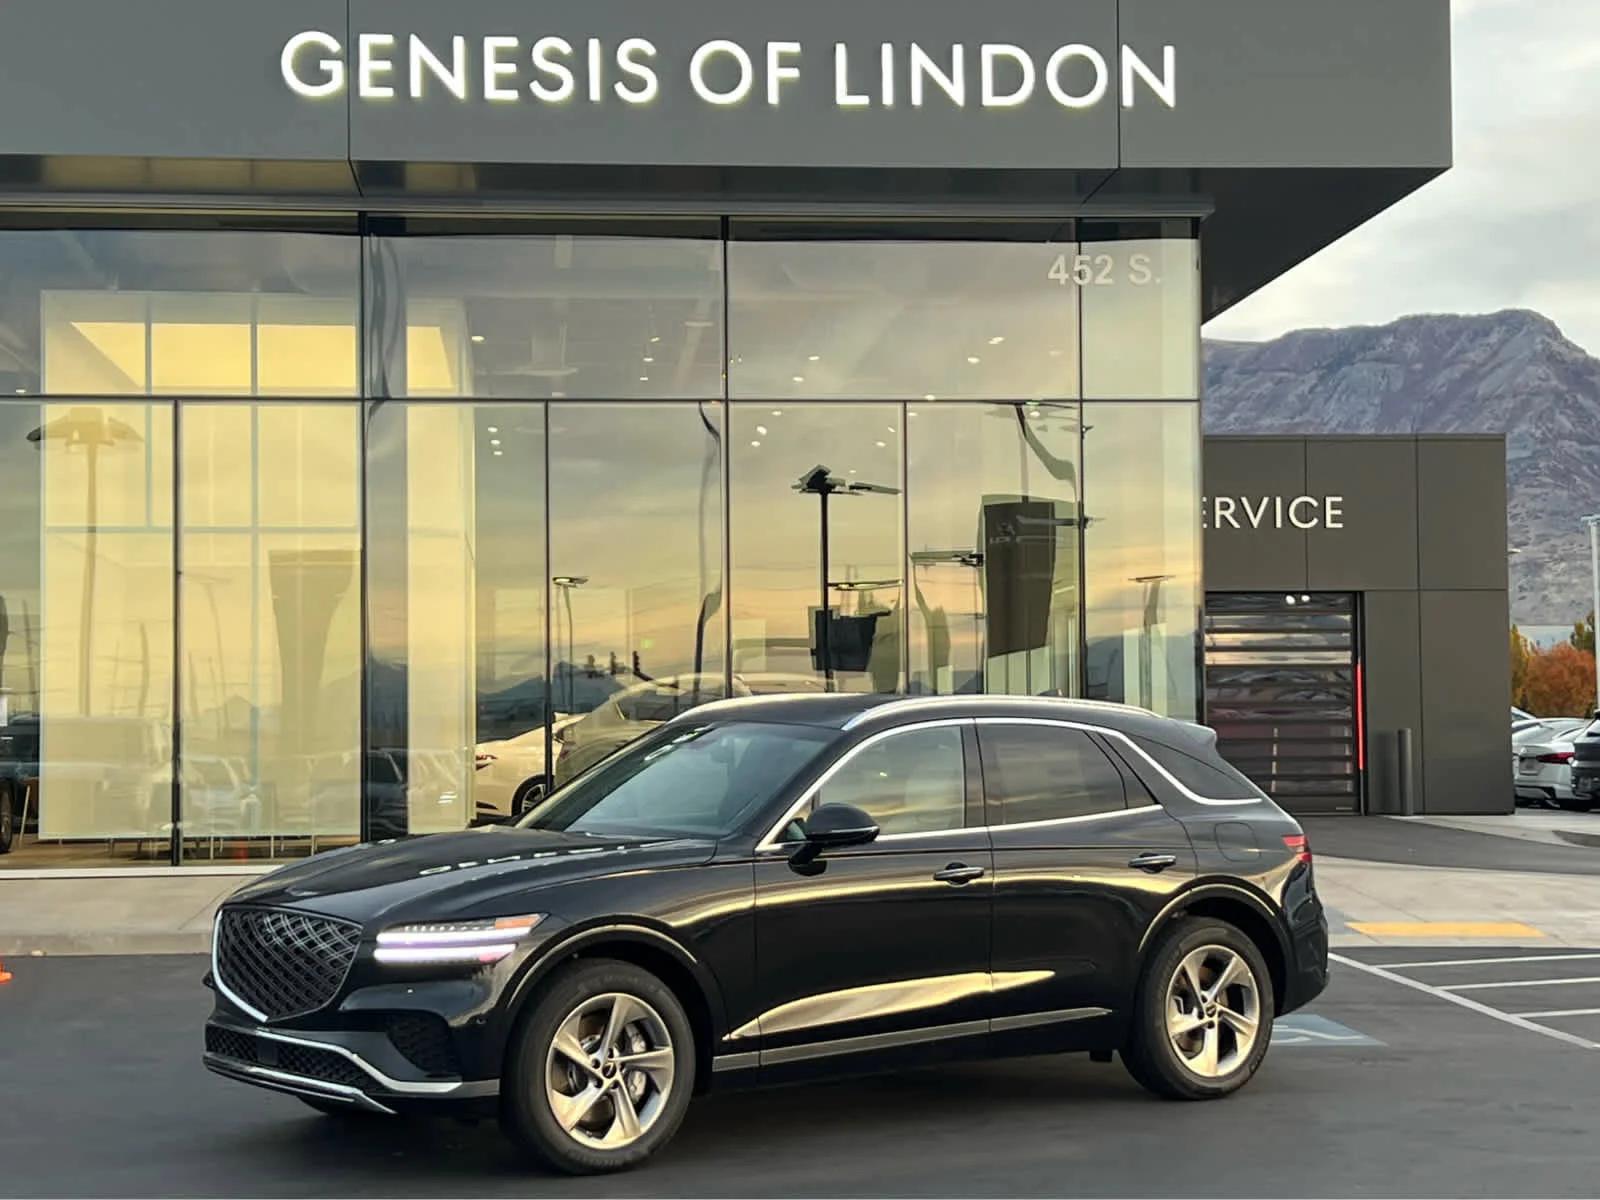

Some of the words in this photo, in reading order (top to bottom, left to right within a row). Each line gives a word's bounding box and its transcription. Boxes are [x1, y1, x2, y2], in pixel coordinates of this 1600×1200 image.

[281, 31, 658, 105] GENESIS
[690, 40, 801, 105] OF
[834, 43, 1178, 108] LINDON
[1047, 253, 1114, 285] 452
[1129, 253, 1162, 285] S.
